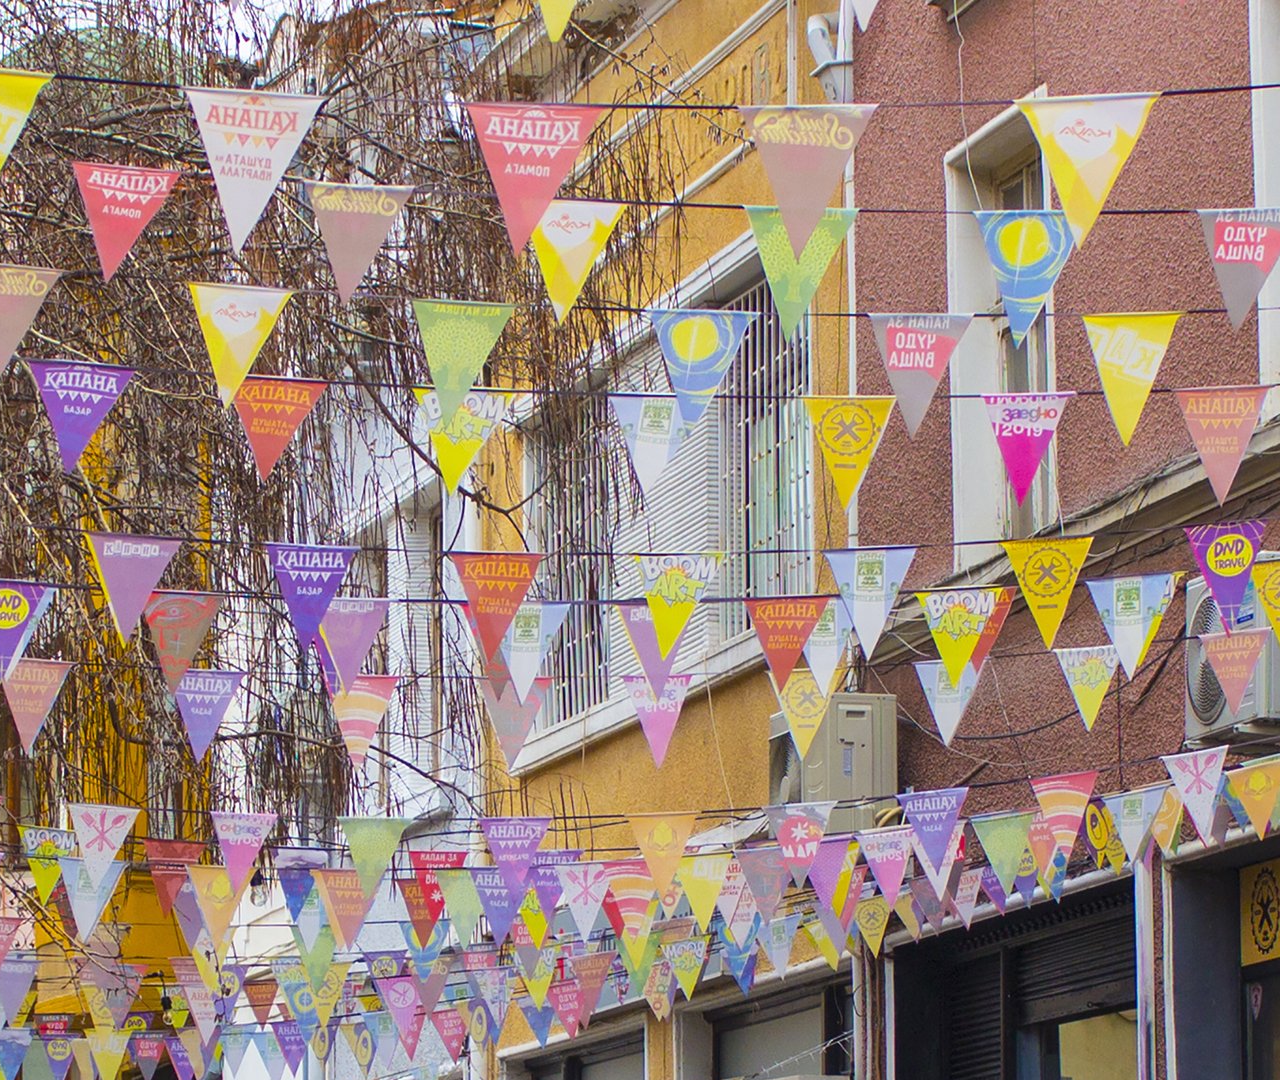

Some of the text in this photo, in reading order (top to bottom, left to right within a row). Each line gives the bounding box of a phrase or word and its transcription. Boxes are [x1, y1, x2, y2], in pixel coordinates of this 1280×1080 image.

[44, 370, 119, 394] КАПАНА
[239, 385, 311, 406] КАПАНА
[64, 405, 92, 417] БАЗАР
[1214, 539, 1246, 556] DND
[276, 550, 346, 568] КАПАНА
[644, 555, 720, 580] BOOM
[1214, 555, 1246, 570] TRAVEL
[464, 562, 531, 580] КАПАНА
[296, 586, 322, 596] БАЗАР
[650, 574, 707, 603] ART
[755, 604, 817, 620] КАПАНА
[927, 590, 996, 617] BOOM
[936, 609, 986, 634] ART
[768, 636, 799, 645] ДУШАТА
[25, 829, 76, 851] BOOM
